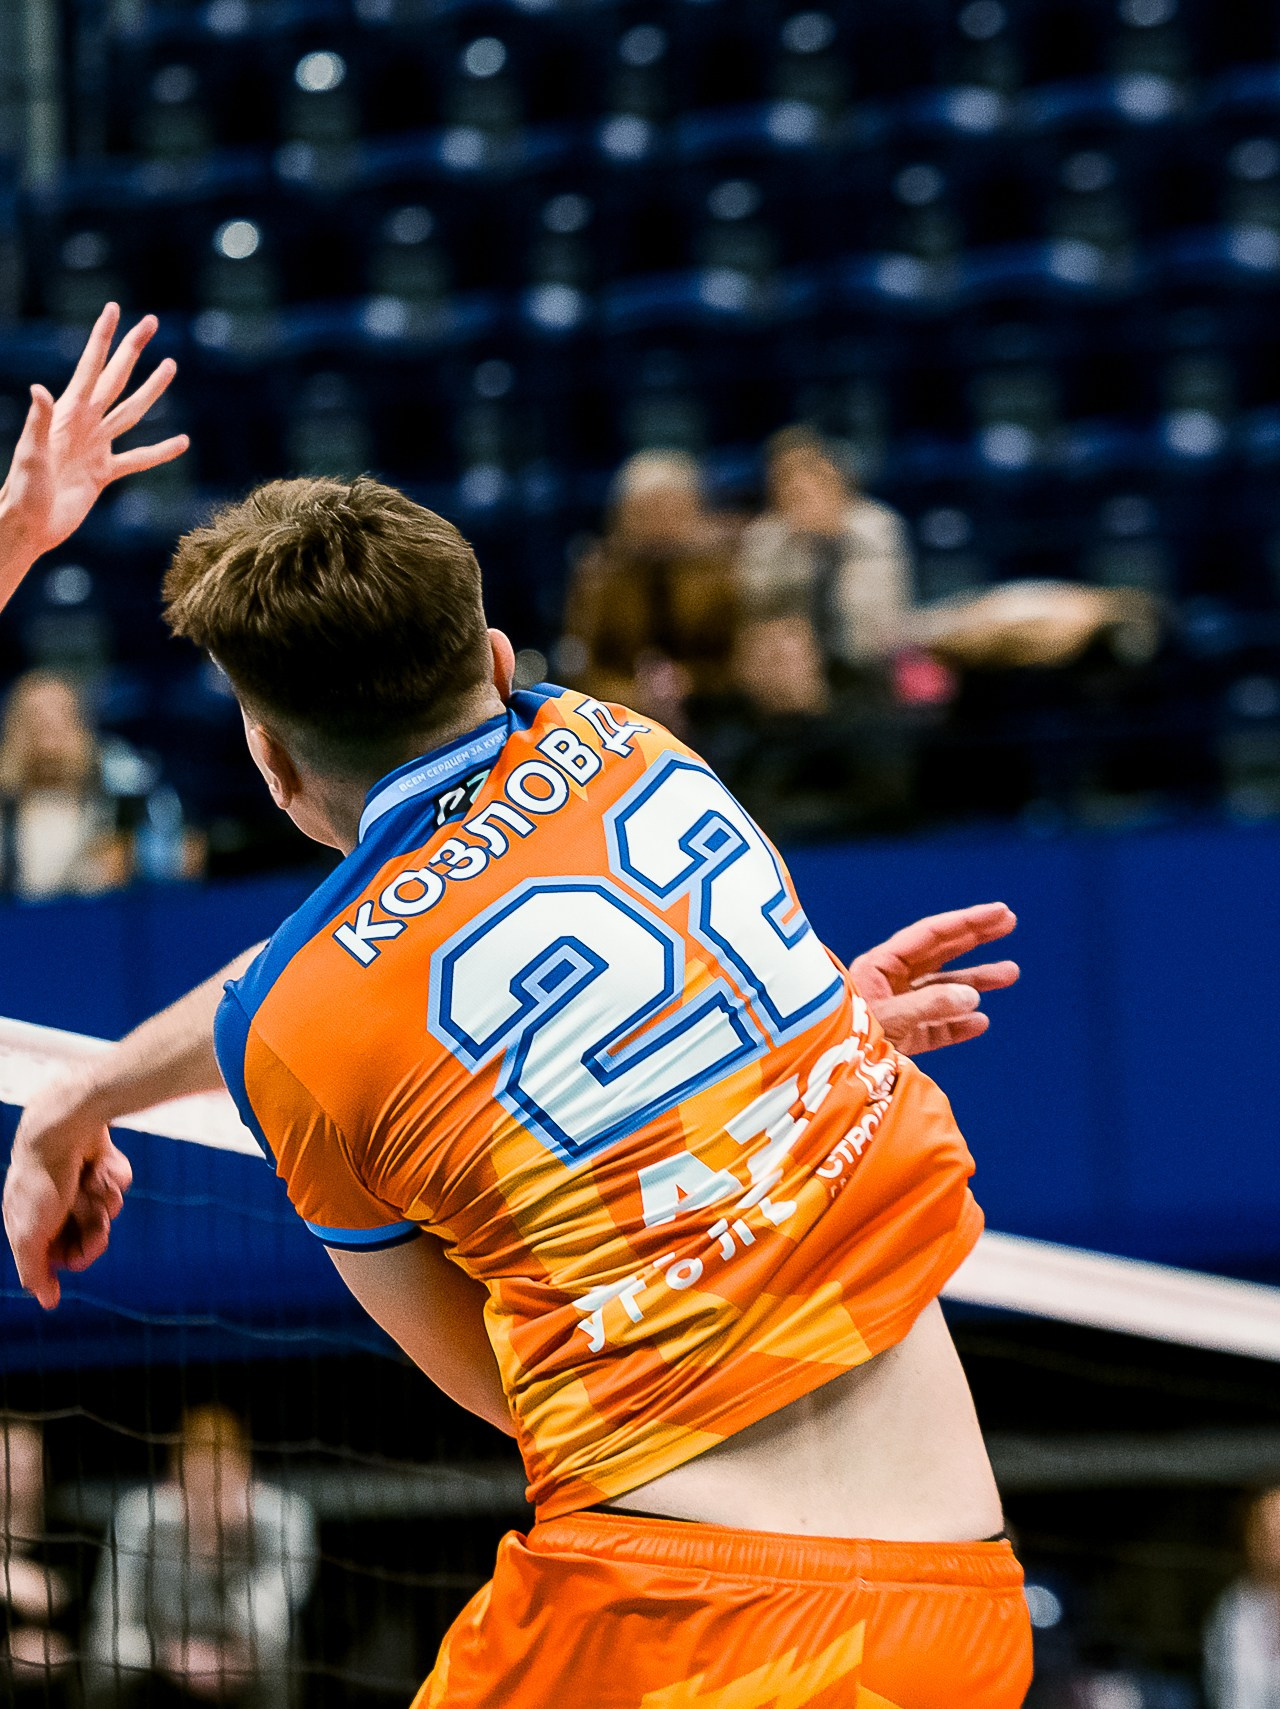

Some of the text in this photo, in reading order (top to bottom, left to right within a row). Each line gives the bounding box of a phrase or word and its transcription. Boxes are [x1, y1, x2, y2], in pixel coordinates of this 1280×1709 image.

[333, 727, 602, 968] КОЗЛОВ
[398, 773, 428, 792] ВСЕМ
[427, 752, 470, 778] СЕРДЦЕМ
[470, 745, 484, 756] ЗА
[426, 749, 848, 1170] 22
